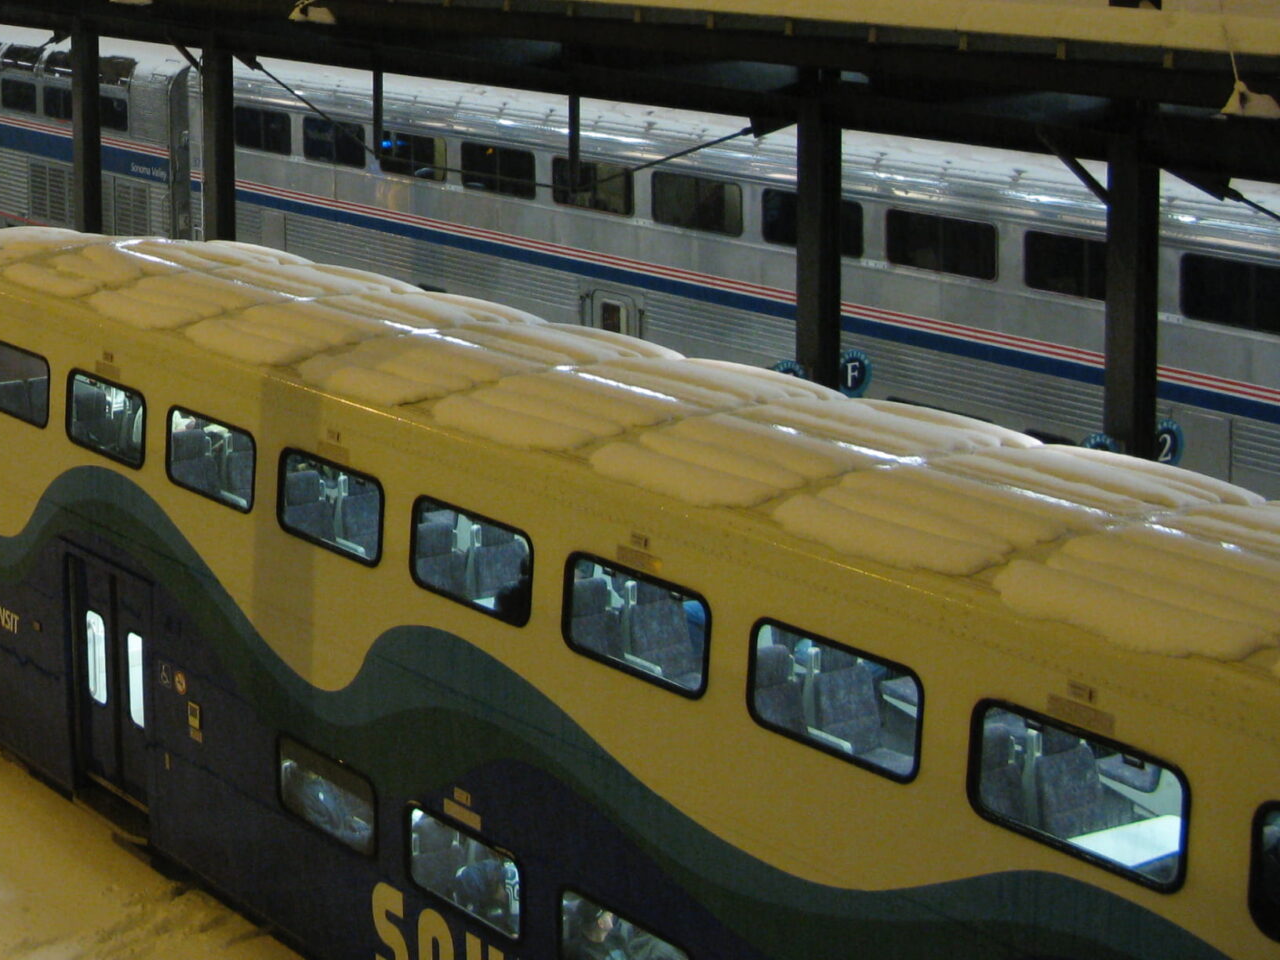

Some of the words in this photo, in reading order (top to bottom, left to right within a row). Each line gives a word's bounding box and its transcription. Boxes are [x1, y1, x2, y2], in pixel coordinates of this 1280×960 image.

[130, 162, 151, 176] Sonoma
[151, 166, 167, 182] Valley
[846, 361, 860, 388] F
[1157, 433, 1172, 462] 2
